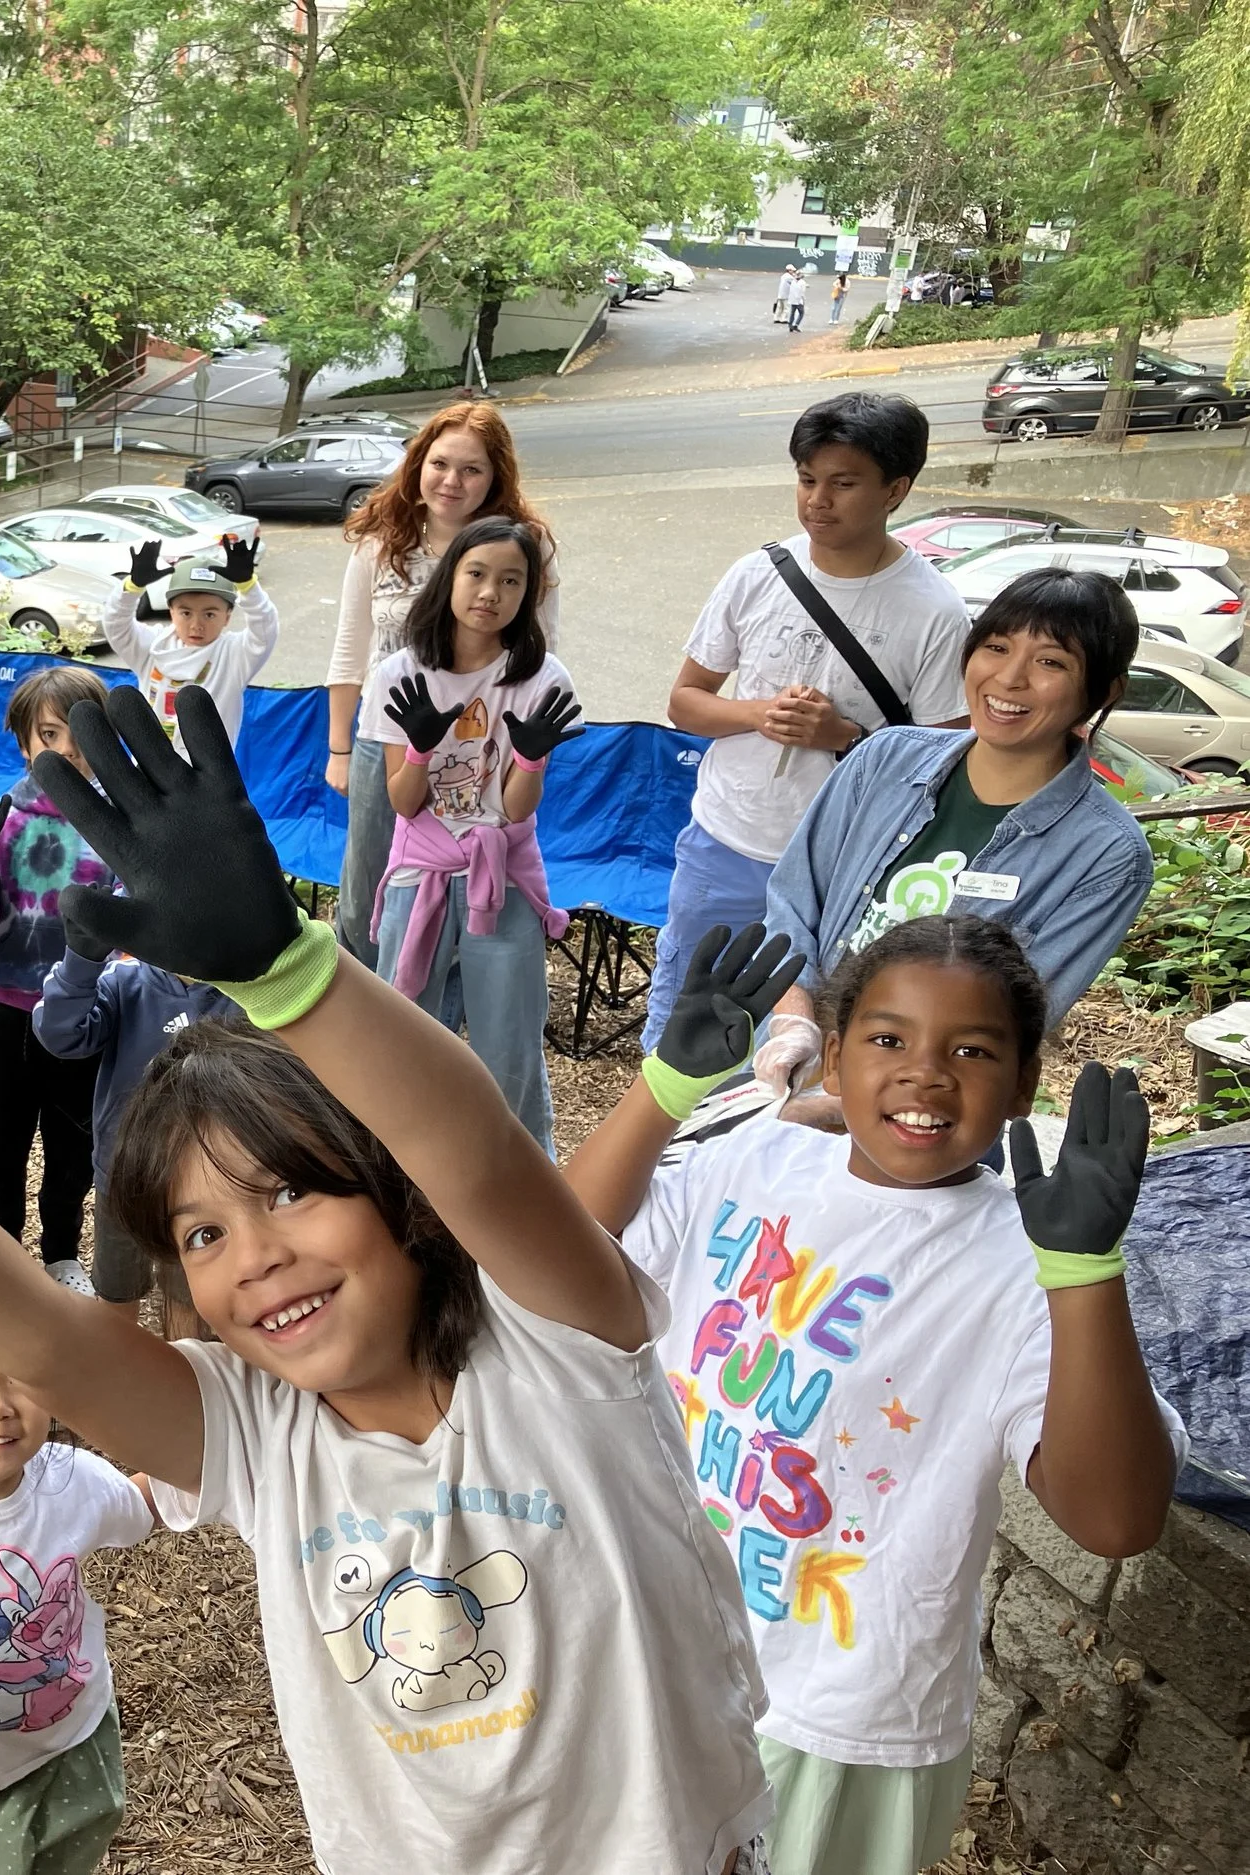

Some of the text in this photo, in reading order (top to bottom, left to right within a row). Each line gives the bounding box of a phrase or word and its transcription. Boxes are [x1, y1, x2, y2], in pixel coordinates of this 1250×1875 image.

[706, 1199, 894, 1364] HAVE
[690, 1299, 833, 1439] FUN
[437, 1481, 567, 1531] music
